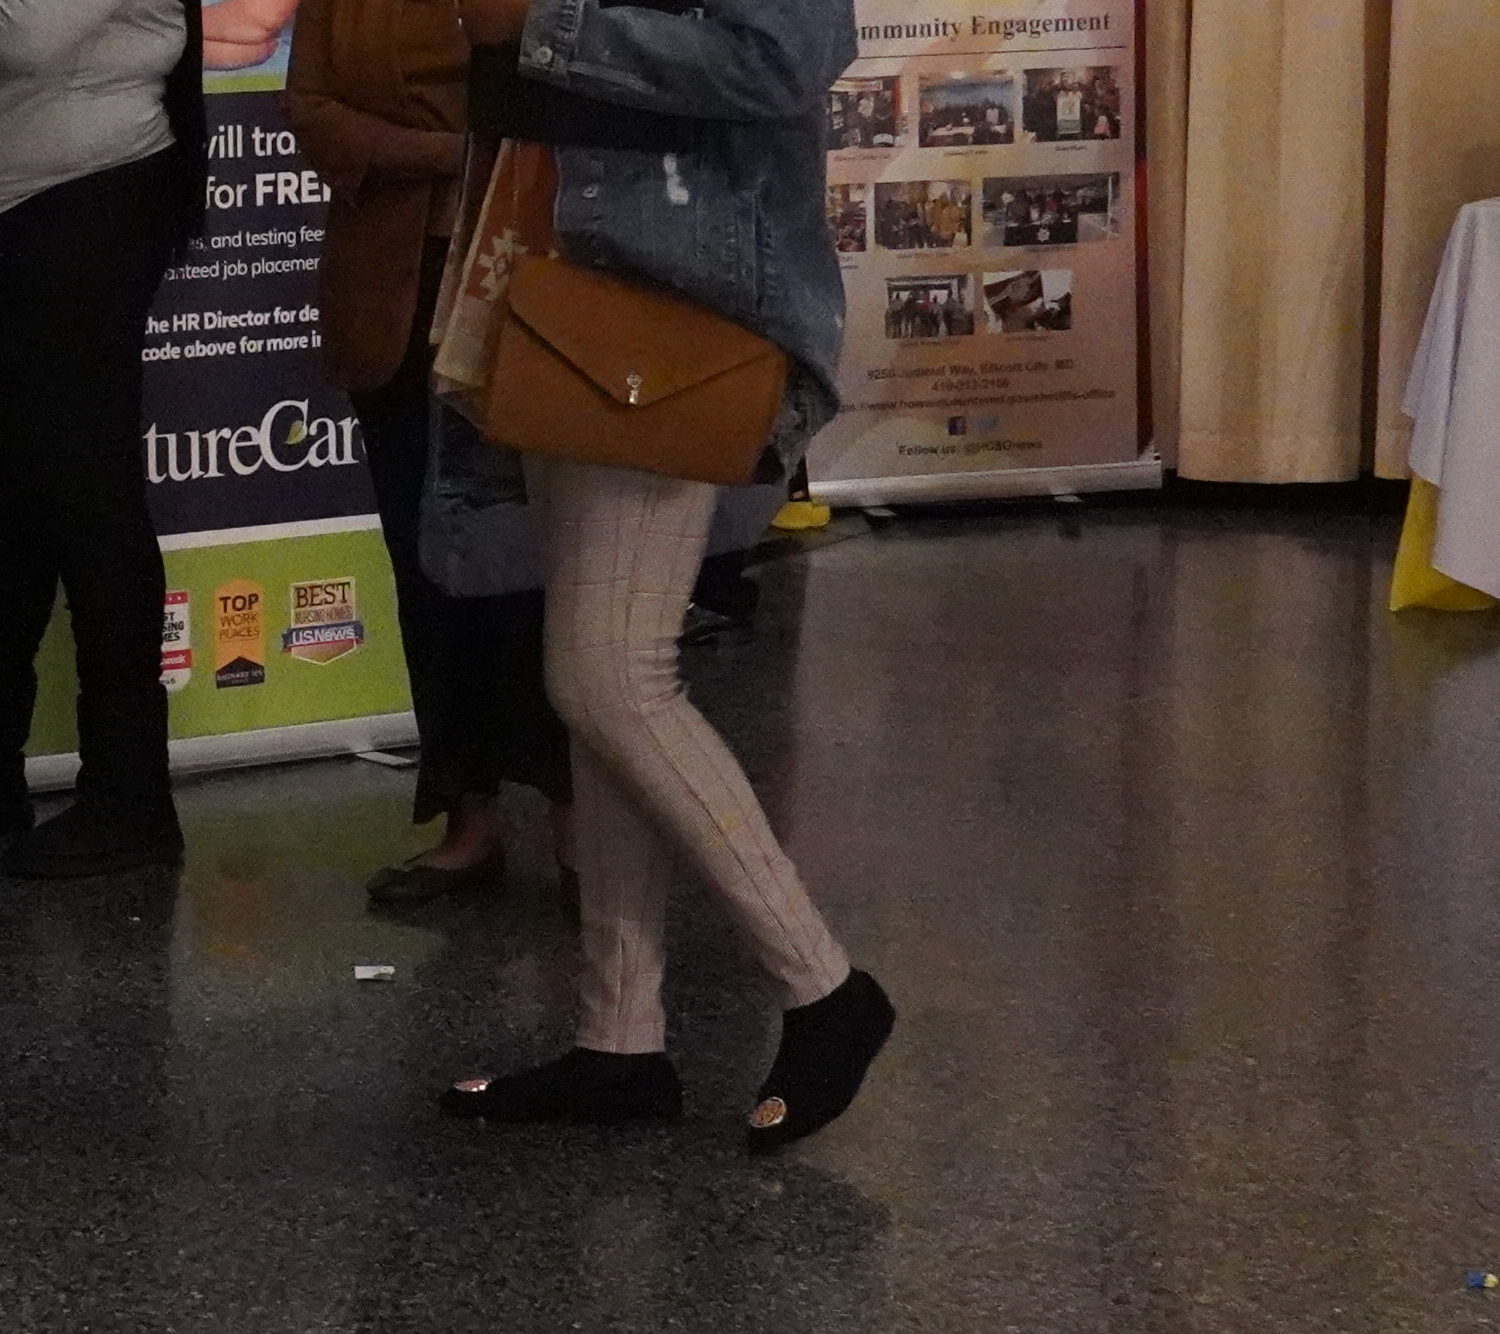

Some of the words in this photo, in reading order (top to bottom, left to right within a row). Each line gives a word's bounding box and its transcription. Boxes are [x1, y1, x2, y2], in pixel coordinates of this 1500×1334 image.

[849, 16, 962, 42] mmunity
[970, 12, 1112, 39] Engagement
[207, 124, 243, 159] ill
[251, 125, 300, 157] tra
[205, 175, 248, 210] for
[211, 231, 242, 249] and
[245, 229, 297, 247] testing
[299, 225, 326, 243] fee
[163, 260, 220, 280] anteed
[222, 259, 248, 281] job
[145, 316, 170, 335] he
[172, 313, 200, 332] HR
[203, 309, 271, 330] Director
[273, 306, 297, 325] for
[299, 304, 319, 322] de
[141, 341, 181, 362] code
[184, 339, 237, 359] above
[239, 335, 265, 354] for
[266, 334, 308, 352] more
[142, 398, 366, 484] tureCar
[219, 593, 259, 613] TOP
[294, 582, 350, 609] BEST
[219, 612, 259, 627] WORK
[219, 626, 260, 639] PLACES
